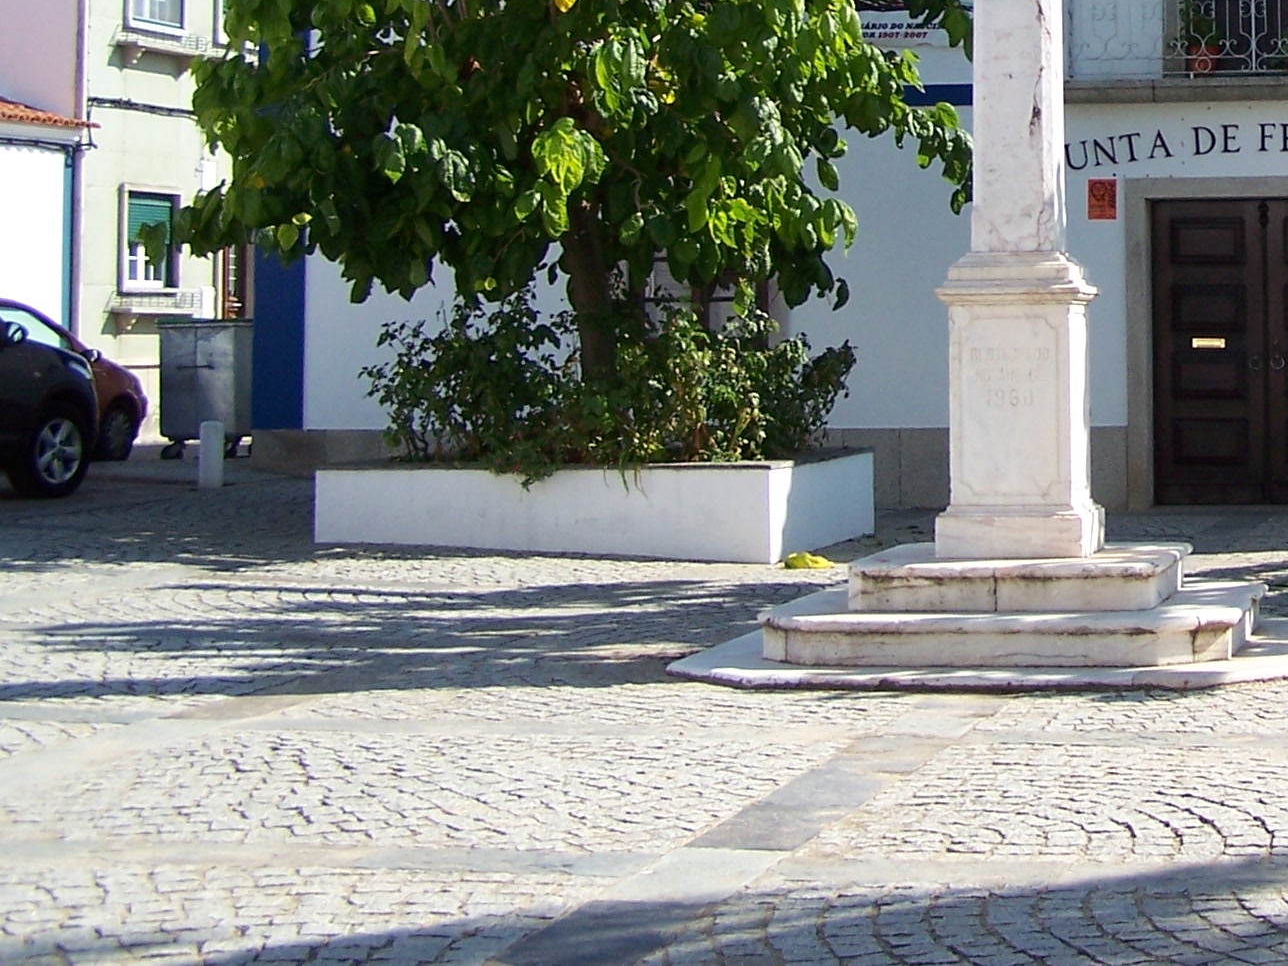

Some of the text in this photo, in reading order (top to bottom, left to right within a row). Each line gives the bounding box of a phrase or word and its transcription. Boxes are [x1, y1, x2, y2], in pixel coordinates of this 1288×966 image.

[889, 22, 905, 30] DO
[1064, 129, 1174, 171] UNTA
[1192, 123, 1242, 156] DE
